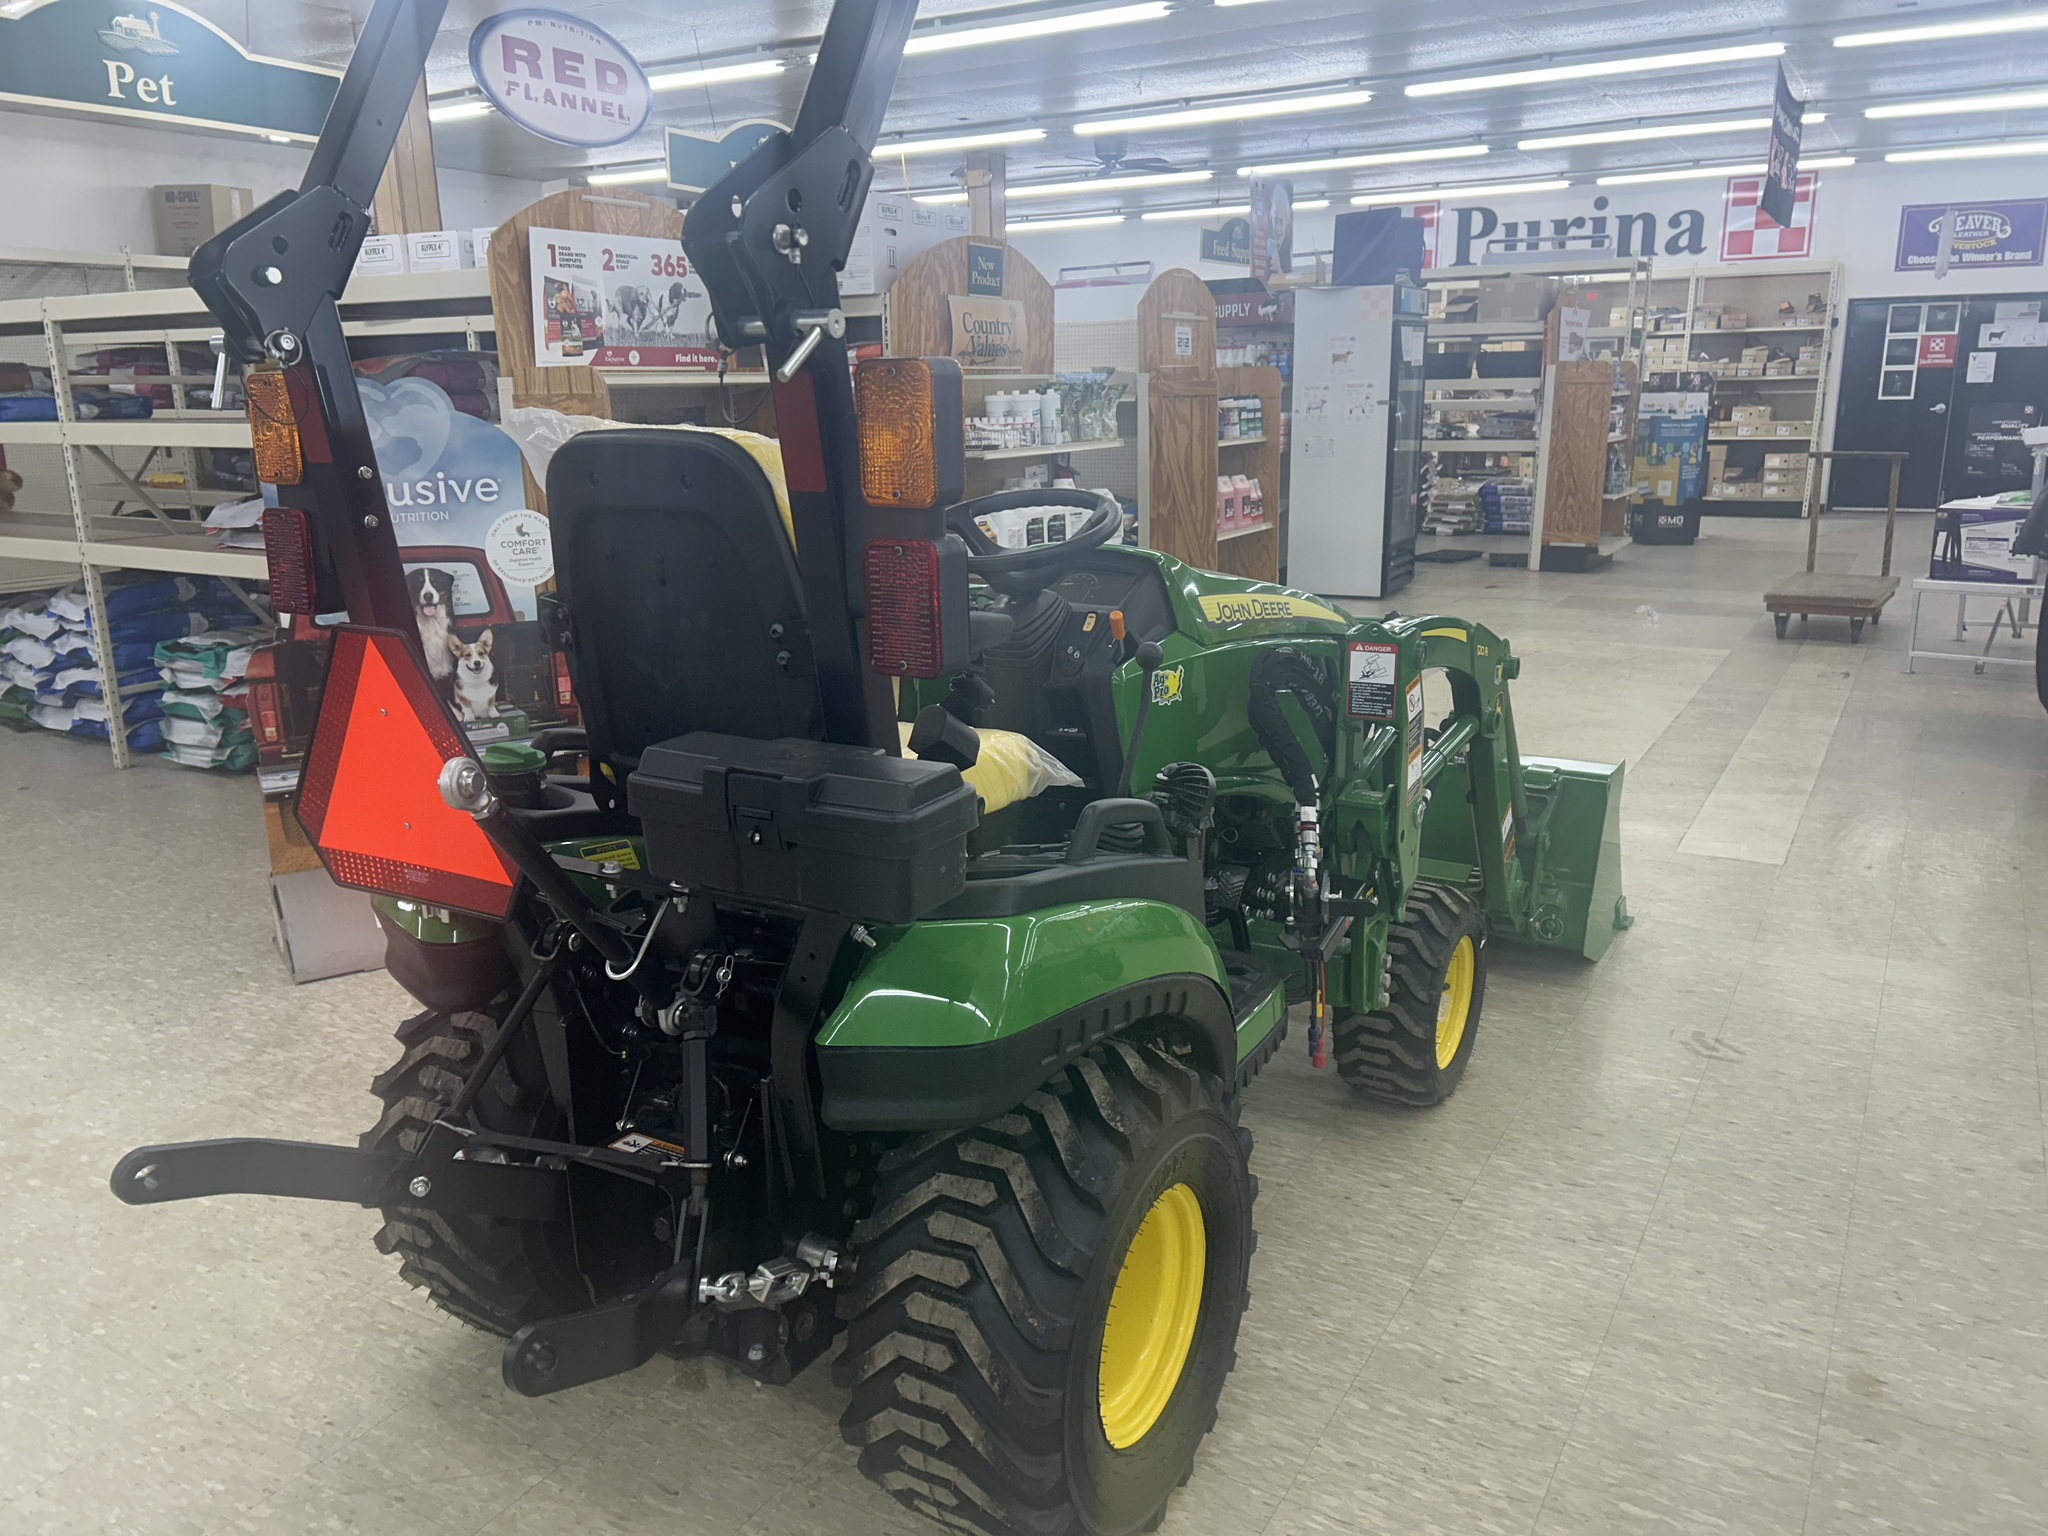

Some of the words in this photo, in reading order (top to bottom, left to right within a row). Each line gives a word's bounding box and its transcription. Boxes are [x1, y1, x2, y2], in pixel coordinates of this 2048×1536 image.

[501, 34, 628, 95] RED
[102, 59, 177, 106] Pet
[504, 79, 631, 122] FLANNEL
[1449, 196, 1707, 266] Purina
[1213, 240, 1229, 257] Feed
[1952, 239, 1998, 250] VESTOCK
[547, 244, 557, 267] 1
[601, 248, 615, 271] 2
[977, 255, 995, 271] New
[1908, 255, 1937, 264] Choos
[1962, 252, 2002, 262] Winner's
[2005, 250, 2032, 260] Brand
[650, 253, 688, 278] 365
[972, 270, 1001, 287] Product
[962, 312, 1013, 340] Country
[969, 335, 1009, 357] Values
[675, 353, 691, 363] Find
[692, 354, 698, 362] it
[699, 354, 718, 363] here.
[387, 472, 500, 507] usive
[391, 511, 449, 524] UTRITION
[502, 514, 518, 523] FROM
[1668, 515, 1684, 526] MQ
[501, 539, 547, 549] COMFORT
[1215, 602, 1252, 621] JOHN
[1251, 599, 1293, 617] DEERE
[1364, 645, 1392, 653] DANGER
[1153, 686, 1169, 699] Pro
